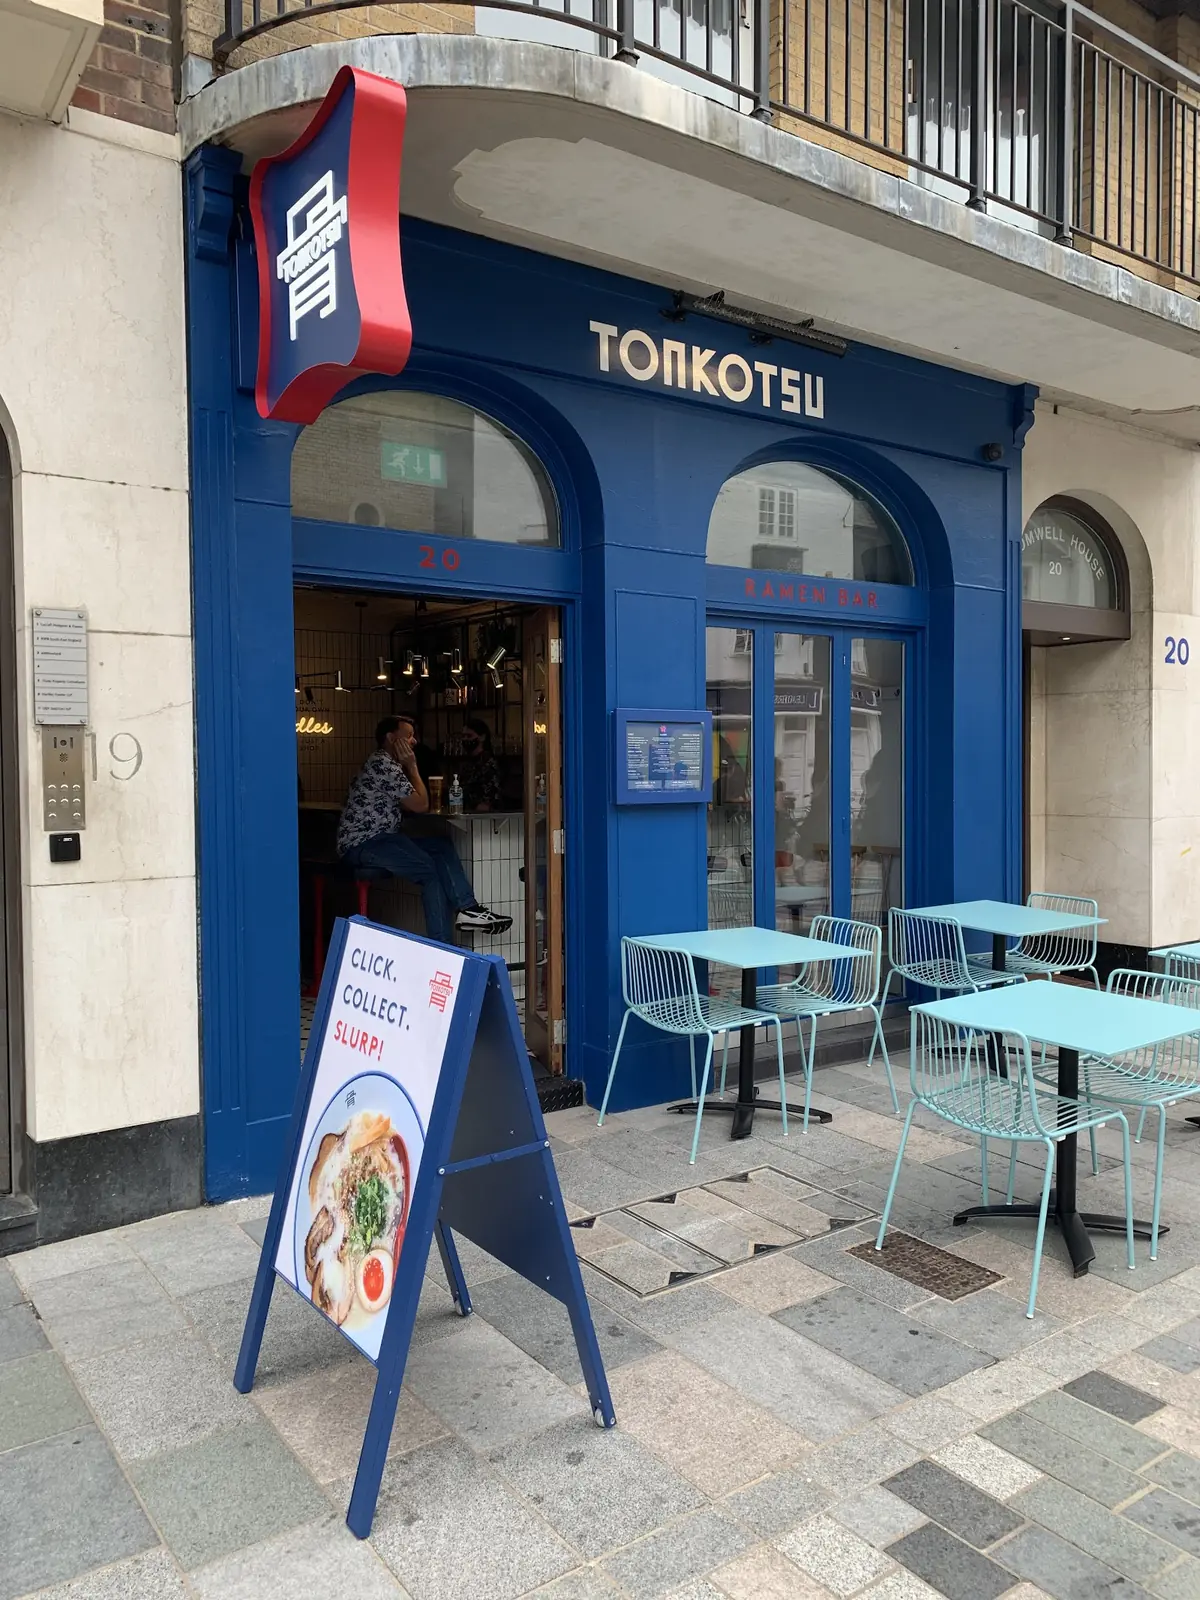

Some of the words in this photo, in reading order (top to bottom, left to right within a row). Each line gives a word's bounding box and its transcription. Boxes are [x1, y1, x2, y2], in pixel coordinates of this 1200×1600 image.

[589, 320, 825, 420] TONKOTSU
[419, 545, 461, 572] 20
[1048, 561, 1063, 576] 20
[1070, 534, 1105, 581] HOUSE
[744, 577, 826, 605] RAMEN
[837, 587, 879, 609] BAR
[1164, 636, 1190, 666] 20
[85, 732, 143, 782] 19
[351, 947, 397, 983] CLICK.
[342, 983, 411, 1031] COLLECT.
[333, 1019, 384, 1062] SLURP!
